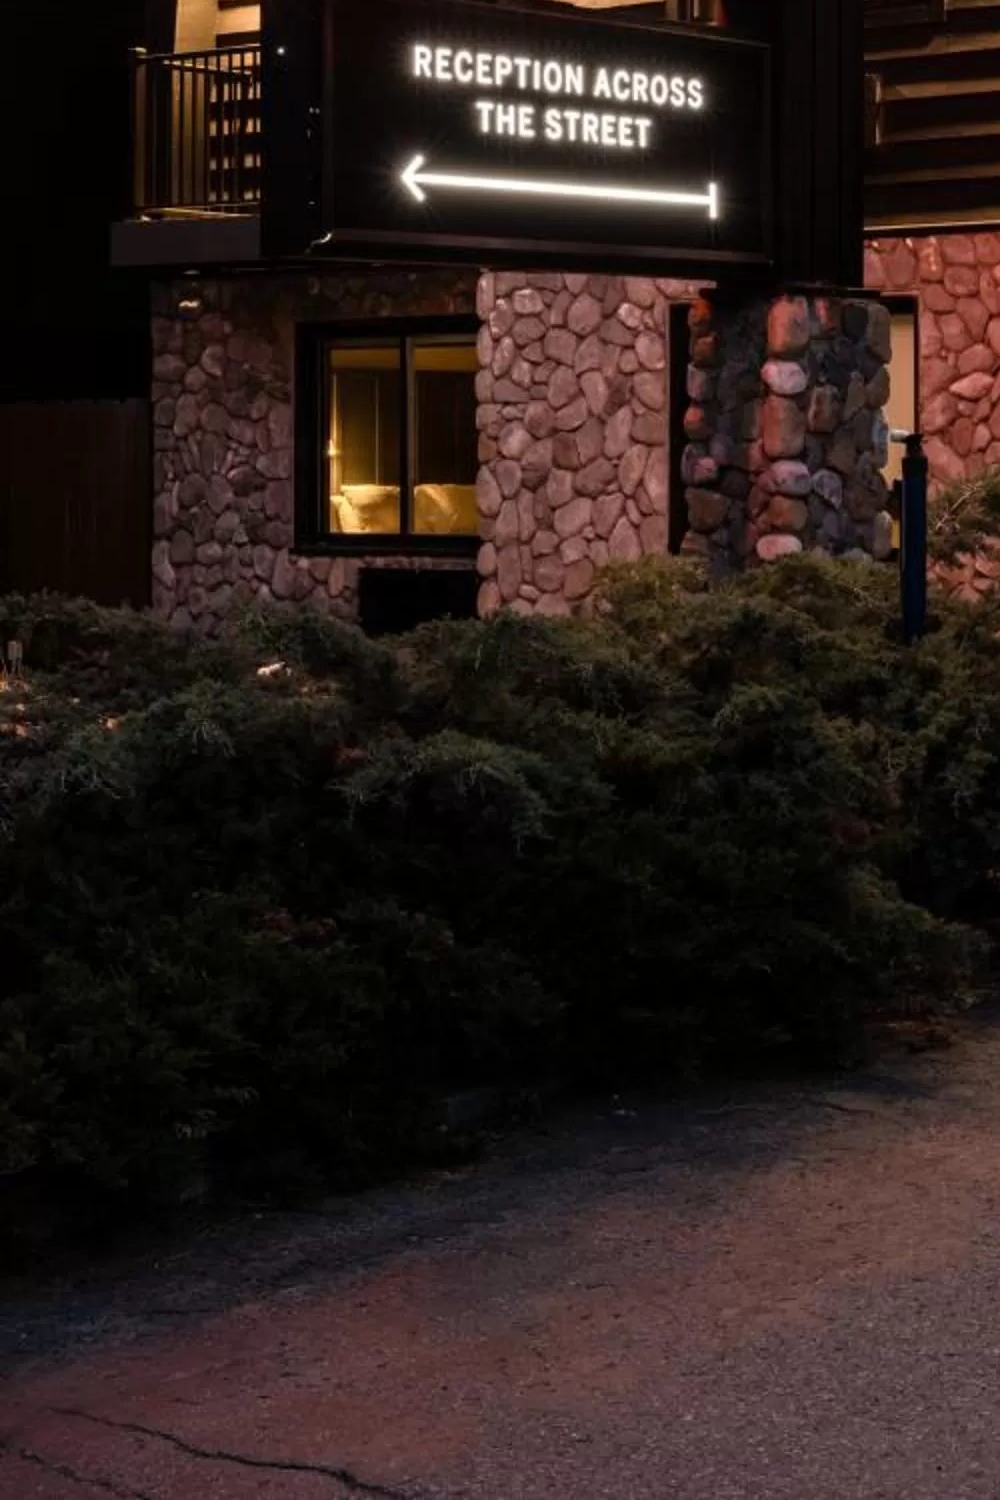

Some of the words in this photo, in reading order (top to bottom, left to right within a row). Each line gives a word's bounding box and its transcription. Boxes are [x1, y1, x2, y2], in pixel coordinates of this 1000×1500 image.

[414, 45, 584, 95] RECEPTION
[594, 68, 705, 108] ACROSS
[476, 102, 535, 138] THE
[545, 115, 653, 148] STREET
